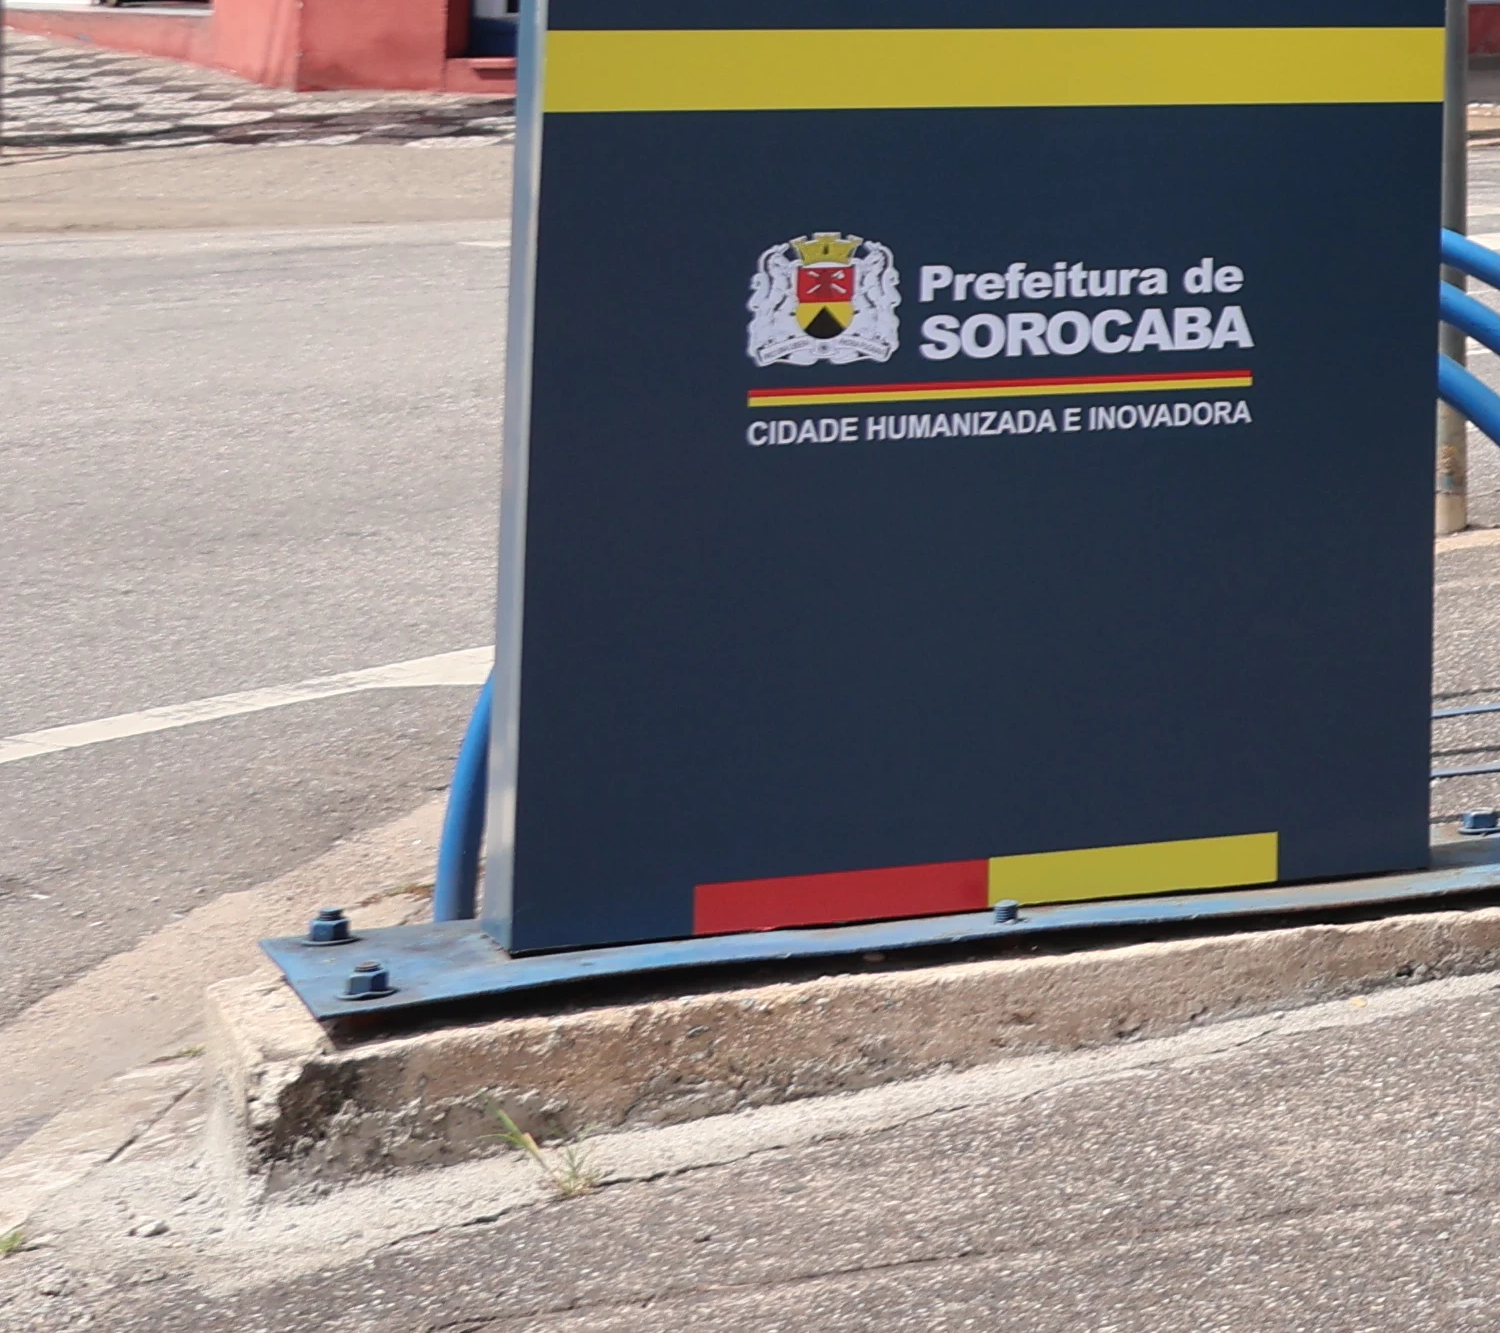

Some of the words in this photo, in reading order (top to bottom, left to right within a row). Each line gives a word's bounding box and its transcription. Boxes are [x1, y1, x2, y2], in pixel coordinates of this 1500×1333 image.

[919, 261, 1168, 302] Prefeitura
[1183, 257, 1244, 293] de
[919, 305, 1254, 361] SOROCABA
[747, 416, 859, 446] CIDADE
[866, 407, 1057, 440] HUMANIZADA
[1063, 407, 1081, 430] E
[1088, 400, 1252, 430] INOVADORA
